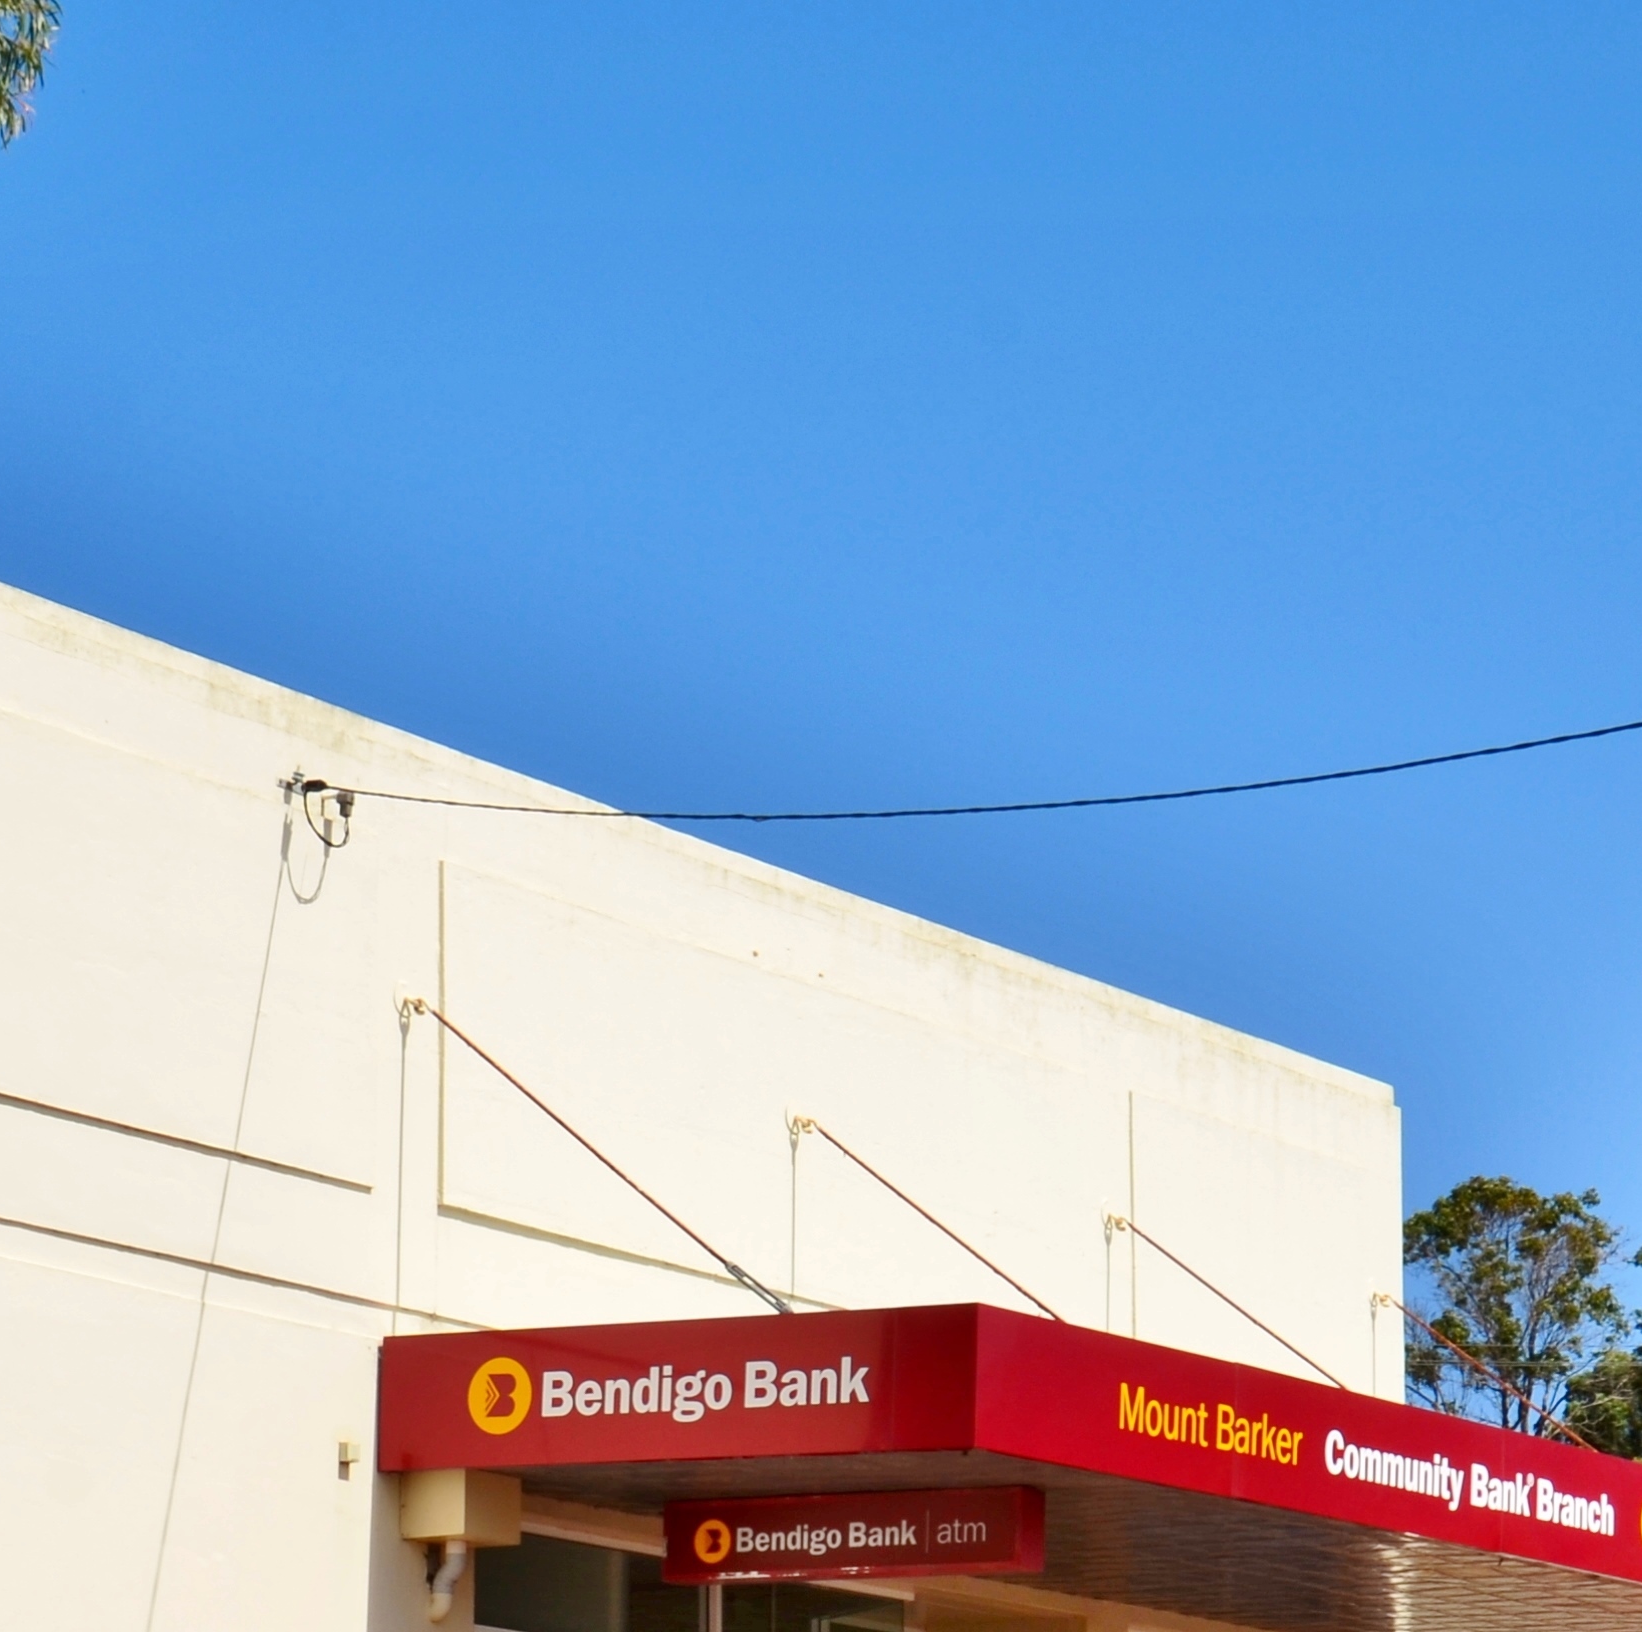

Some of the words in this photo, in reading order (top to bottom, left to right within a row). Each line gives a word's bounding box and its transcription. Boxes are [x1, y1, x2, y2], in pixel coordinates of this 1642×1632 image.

[541, 1365, 733, 1422] Bendigo
[744, 1356, 870, 1408] Bank
[1118, 1382, 1209, 1448] Mount
[1216, 1403, 1304, 1466] Barker
[1324, 1429, 1464, 1511] Community
[1535, 1477, 1615, 1537] Branch
[735, 1525, 842, 1557] Bendigo
[847, 1520, 917, 1546] Bank
[936, 1519, 987, 1545] atm
